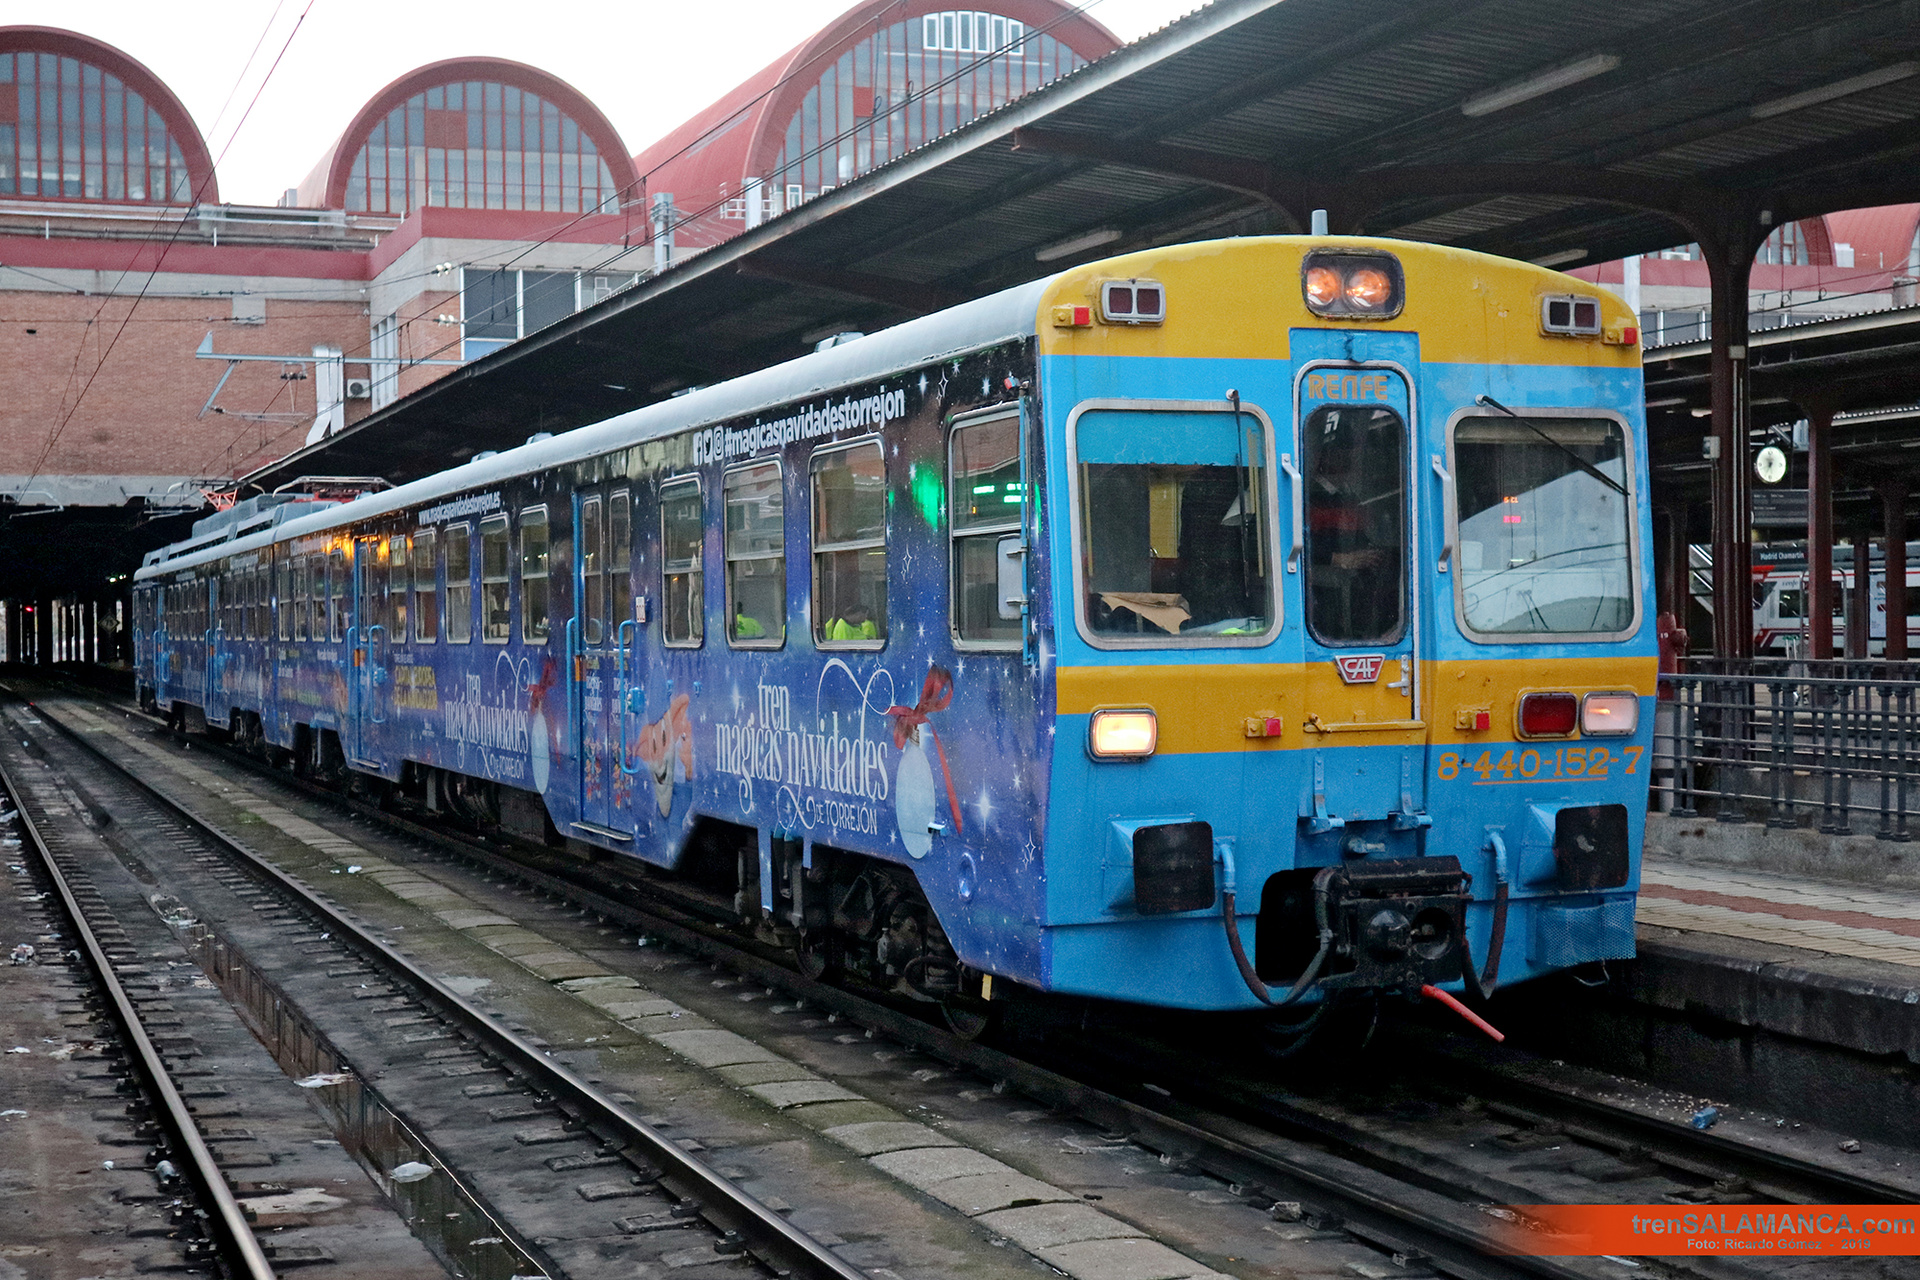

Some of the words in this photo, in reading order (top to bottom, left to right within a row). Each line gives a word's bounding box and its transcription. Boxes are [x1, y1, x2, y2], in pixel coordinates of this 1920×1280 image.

[1308, 374, 1388, 400] RENFE
[724, 385, 905, 457] #magicasnavidadestorrejon
[1760, 552, 1778, 560] Madrid
[1344, 658, 1382, 679] CAF
[466, 669, 481, 706] tren
[757, 676, 790, 732] tren
[1437, 746, 1644, 782] 8-440-152-7
[824, 800, 878, 836] TORREJÓN
